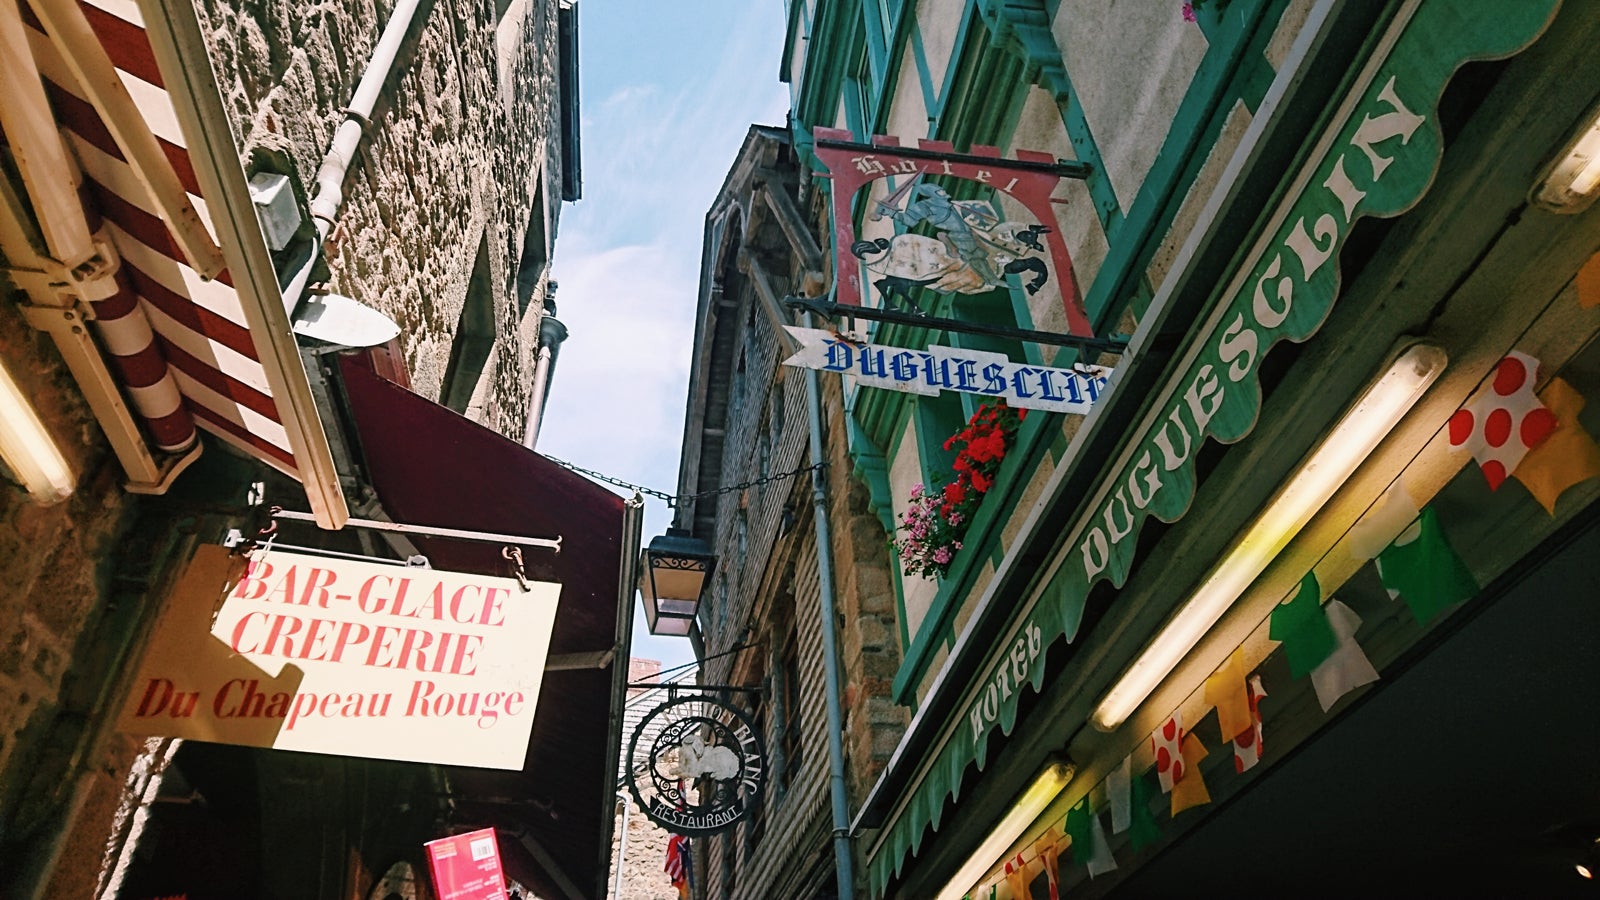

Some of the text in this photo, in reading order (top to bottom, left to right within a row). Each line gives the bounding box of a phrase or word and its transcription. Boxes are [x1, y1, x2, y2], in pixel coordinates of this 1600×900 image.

[851, 155, 1019, 193] Hotel
[233, 561, 511, 627] BAR-GLACE
[231, 611, 484, 676] CREPERIE
[135, 677, 525, 731] Du Chapeau Rouge
[970, 620, 1041, 746] HOTEL
[733, 723, 762, 796] BLANC
[652, 803, 737, 829] RESTAURANT
